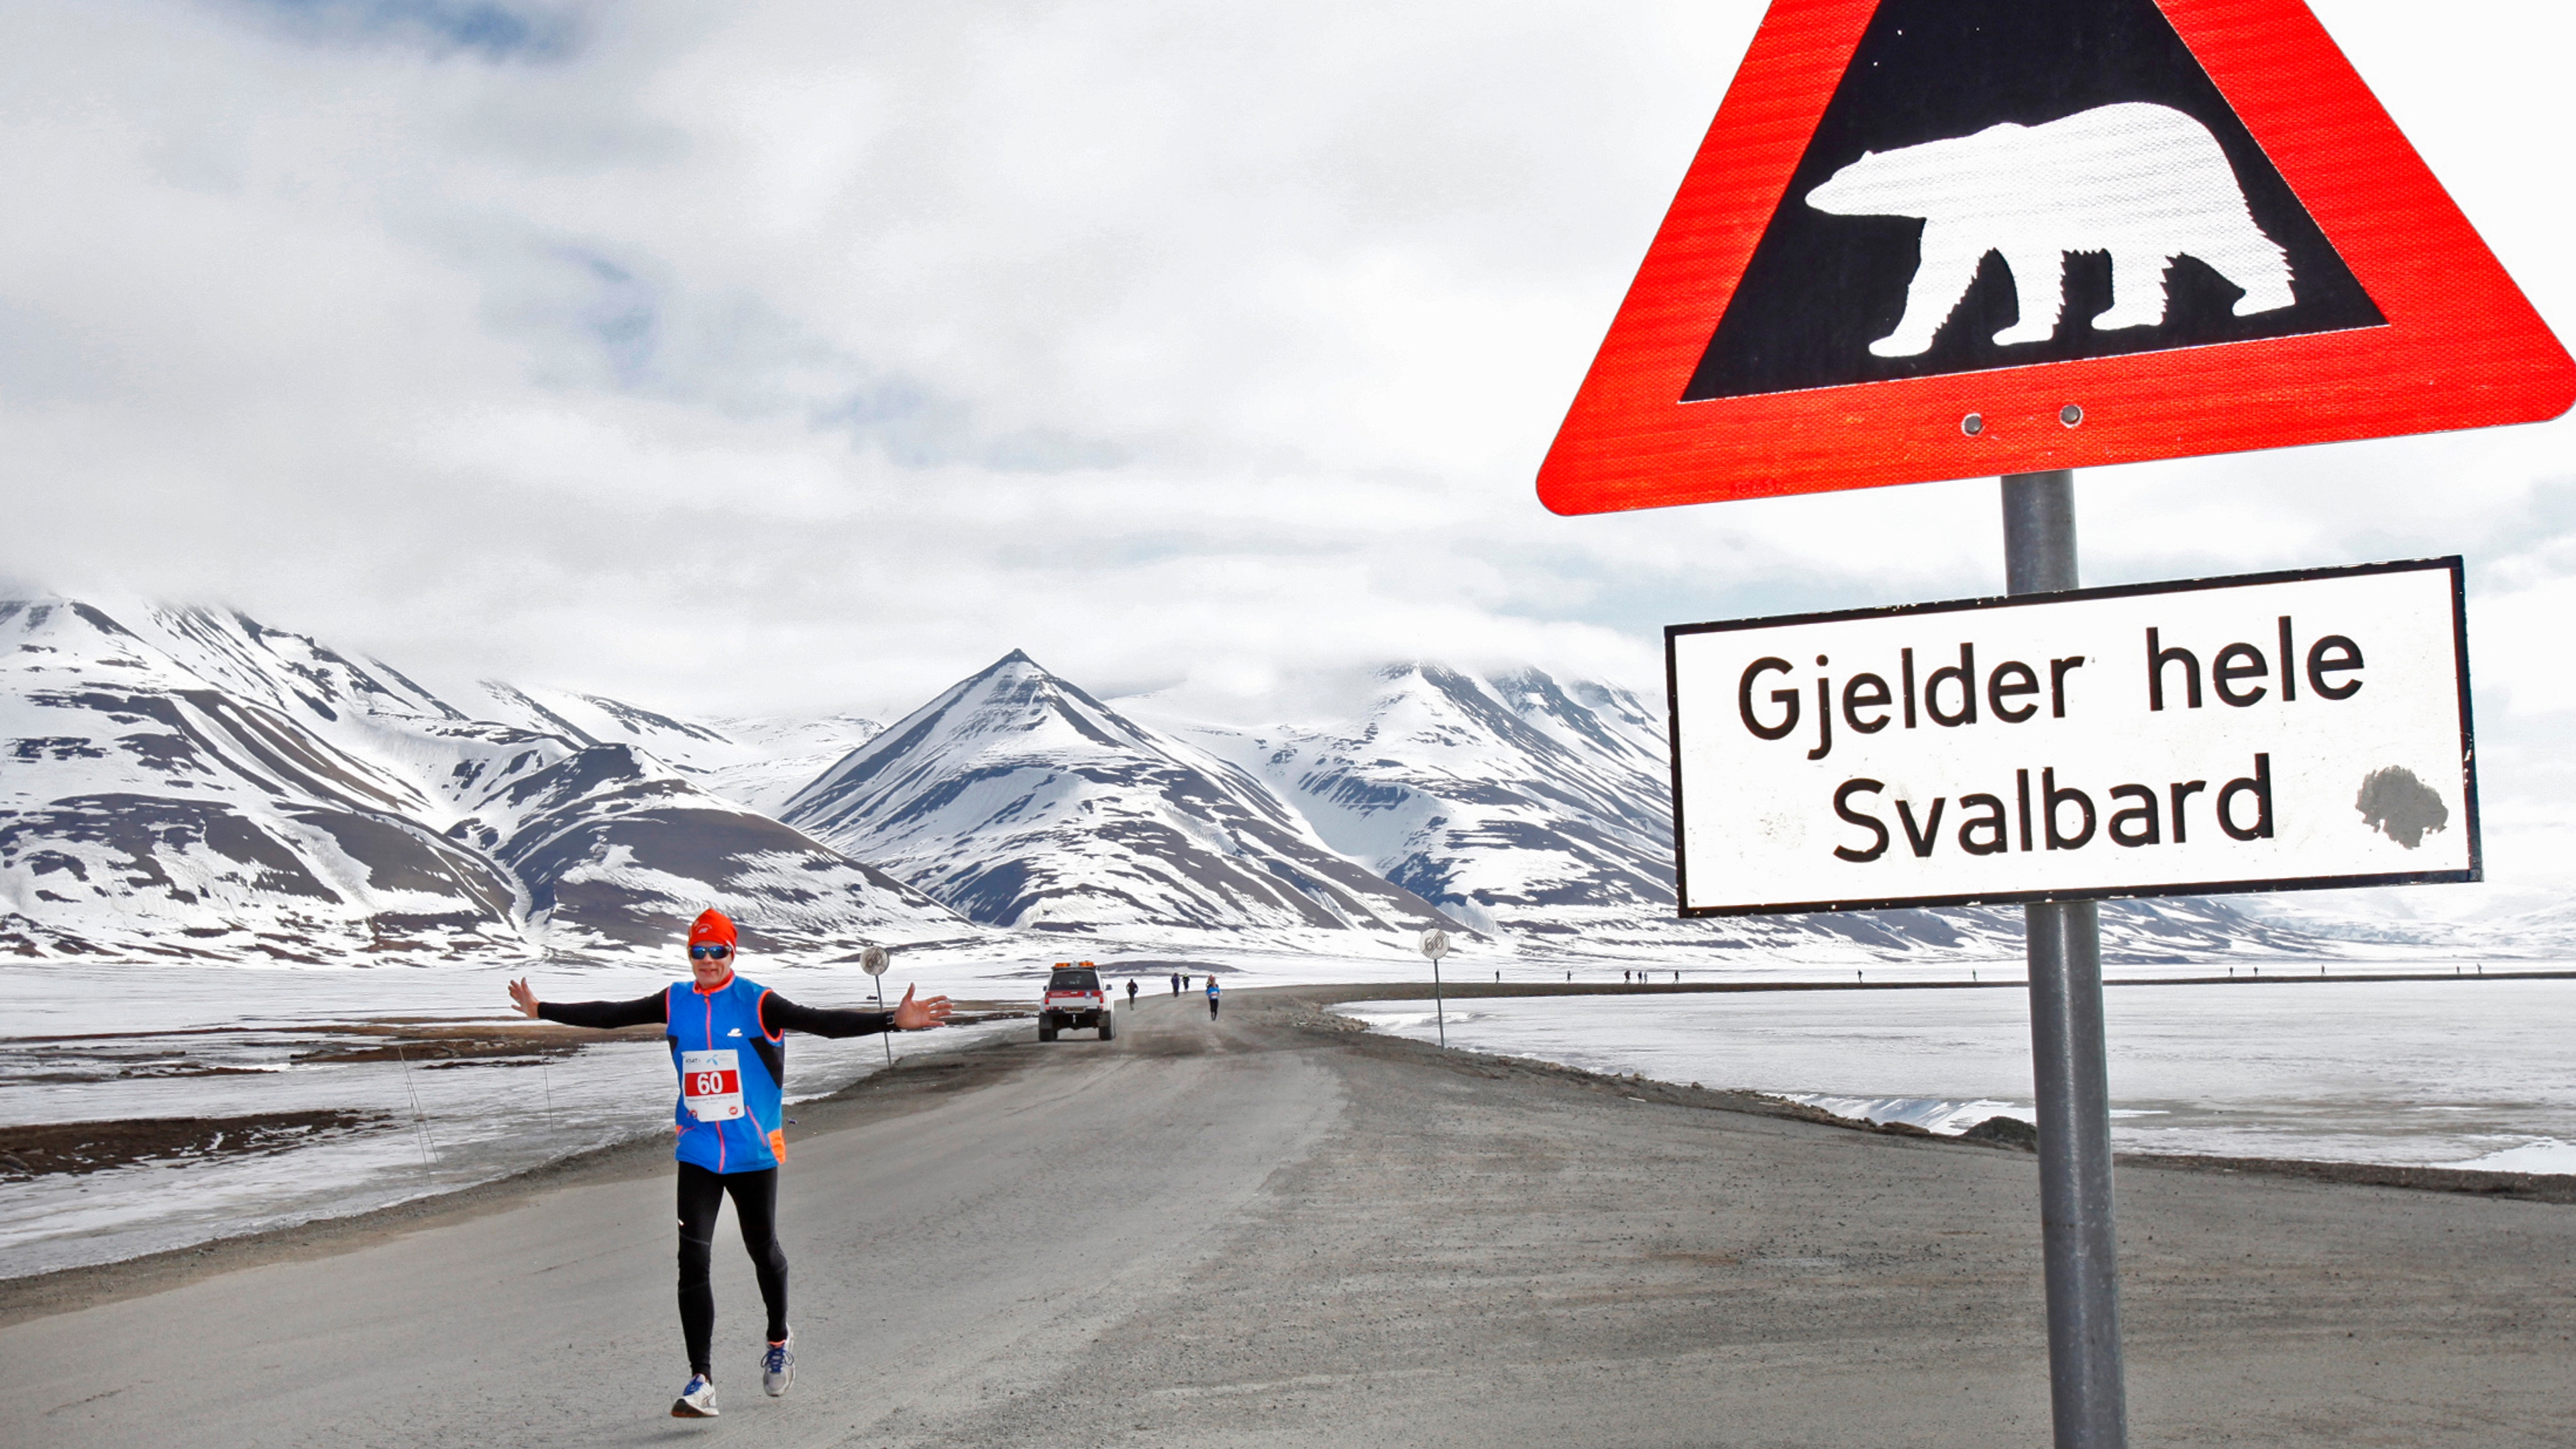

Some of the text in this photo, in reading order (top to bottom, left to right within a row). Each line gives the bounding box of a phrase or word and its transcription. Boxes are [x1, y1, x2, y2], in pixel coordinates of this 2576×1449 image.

[1739, 615, 2364, 761] Gjelder hele
[1833, 753, 2274, 863] Svalbard
[697, 1071, 723, 1095] 60
